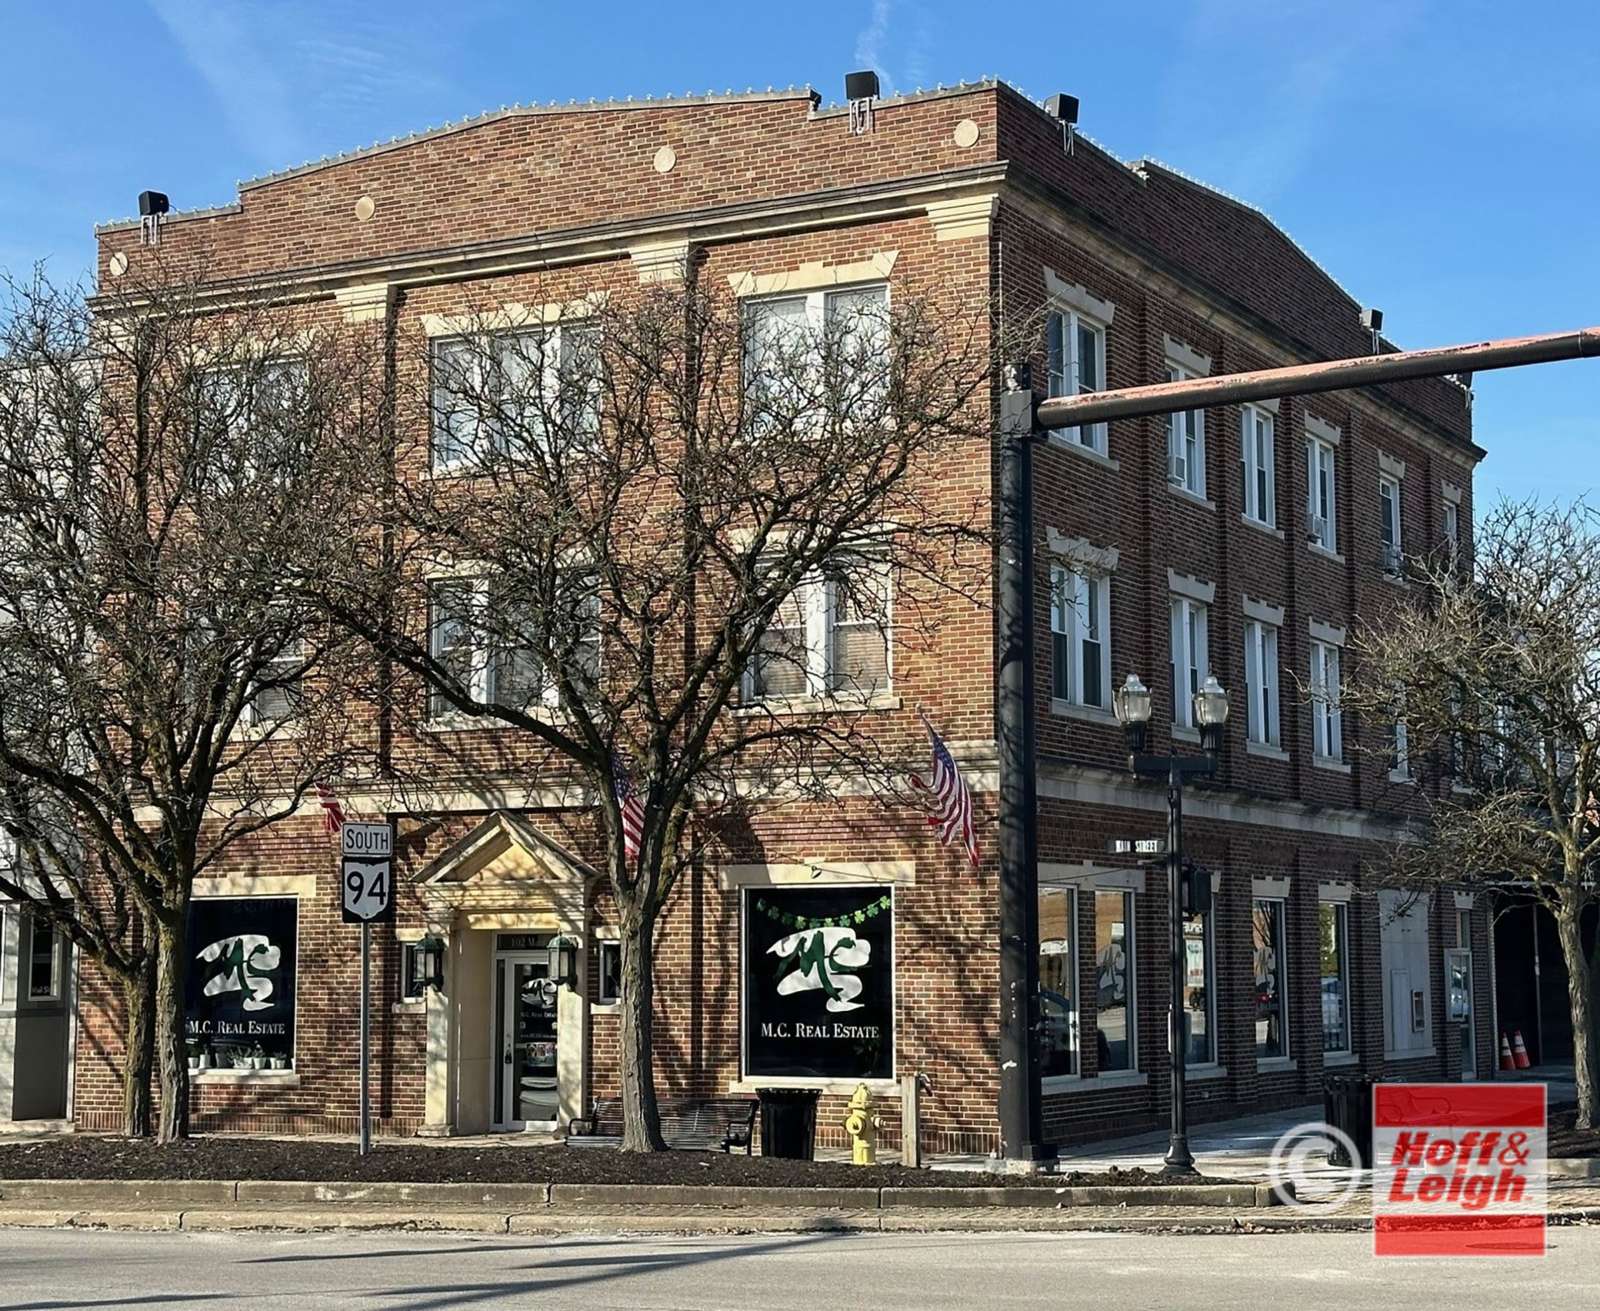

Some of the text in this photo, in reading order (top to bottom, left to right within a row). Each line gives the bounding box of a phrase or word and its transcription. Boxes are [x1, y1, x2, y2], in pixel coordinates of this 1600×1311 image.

[346, 829, 388, 849] SOUTH
[347, 871, 386, 905] 94
[189, 1021, 285, 1034] M.C. REAL ESTATE
[761, 1023, 879, 1038] M.C. REAL ESTATE
